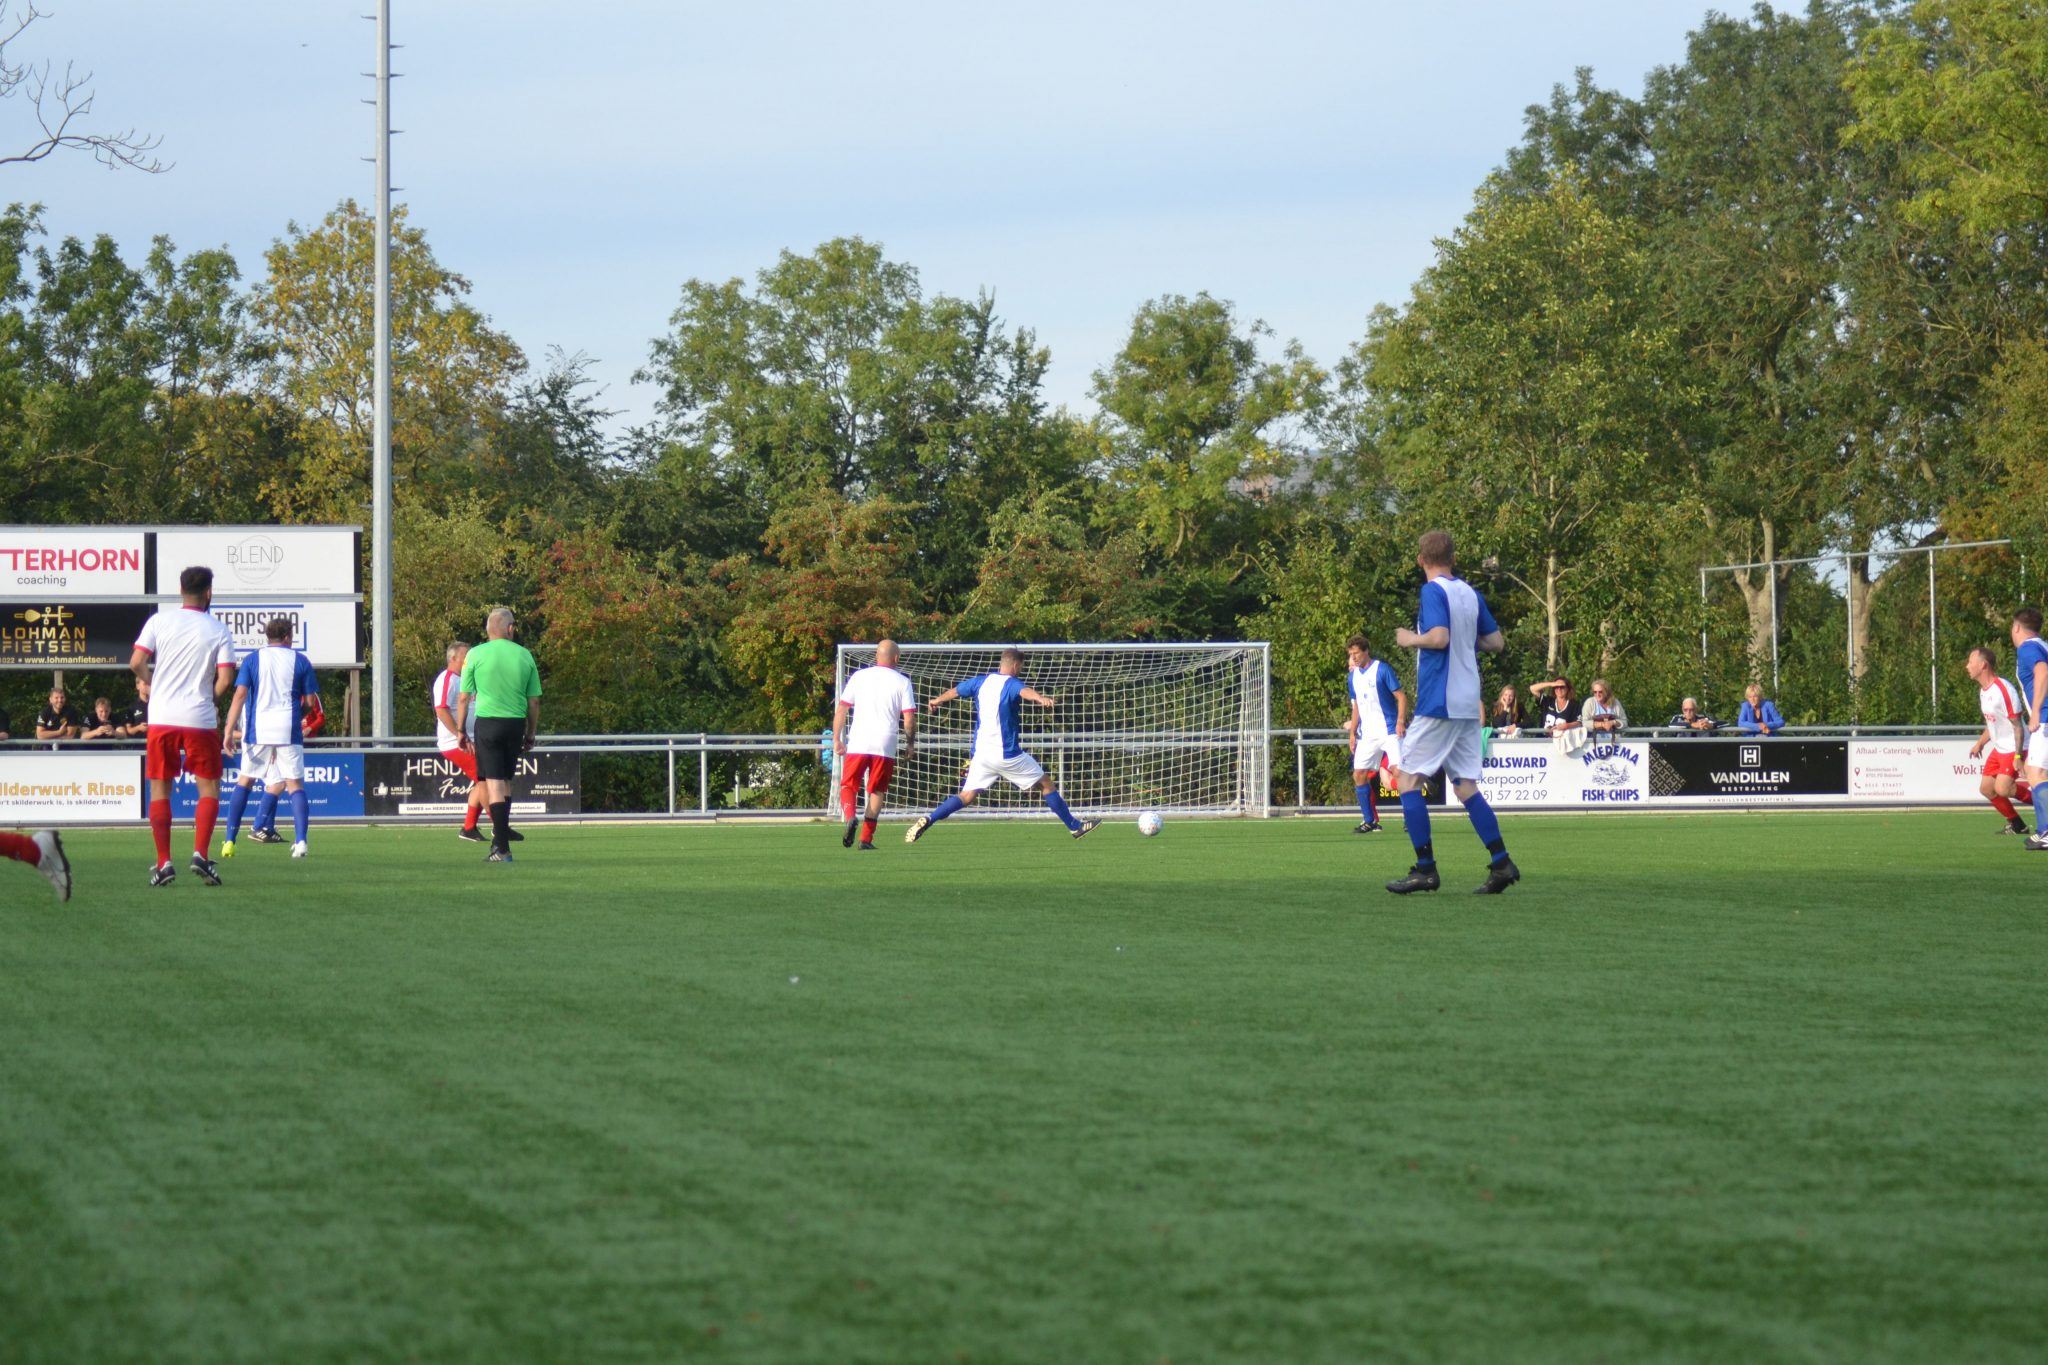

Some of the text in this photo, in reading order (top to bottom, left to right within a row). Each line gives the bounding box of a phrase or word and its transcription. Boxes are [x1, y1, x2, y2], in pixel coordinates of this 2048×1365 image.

[0, 549, 139, 571] TERHORN
[227, 545, 284, 564] BLEND
[17, 575, 67, 586] coaching
[2, 627, 85, 639] LOHMAN
[2, 641, 85, 653] FIETSEN
[241, 638, 267, 646] BOU
[24, 656, 117, 664] www.lohmanfietsen.nl
[1582, 745, 1640, 766] MIEDEMA
[1882, 747, 1911, 756] Catering
[1482, 756, 1548, 769] BOLSWARD
[1953, 764, 1977, 775] Wok
[1538, 772, 1547, 785] 7
[1710, 771, 1790, 784] VANDILLEN
[87, 782, 136, 796] Rinse
[1497, 789, 1512, 801] 57
[1514, 789, 1529, 801] 22
[1532, 789, 1548, 801] 09
[1582, 789, 1640, 801] FISH CHIPS
